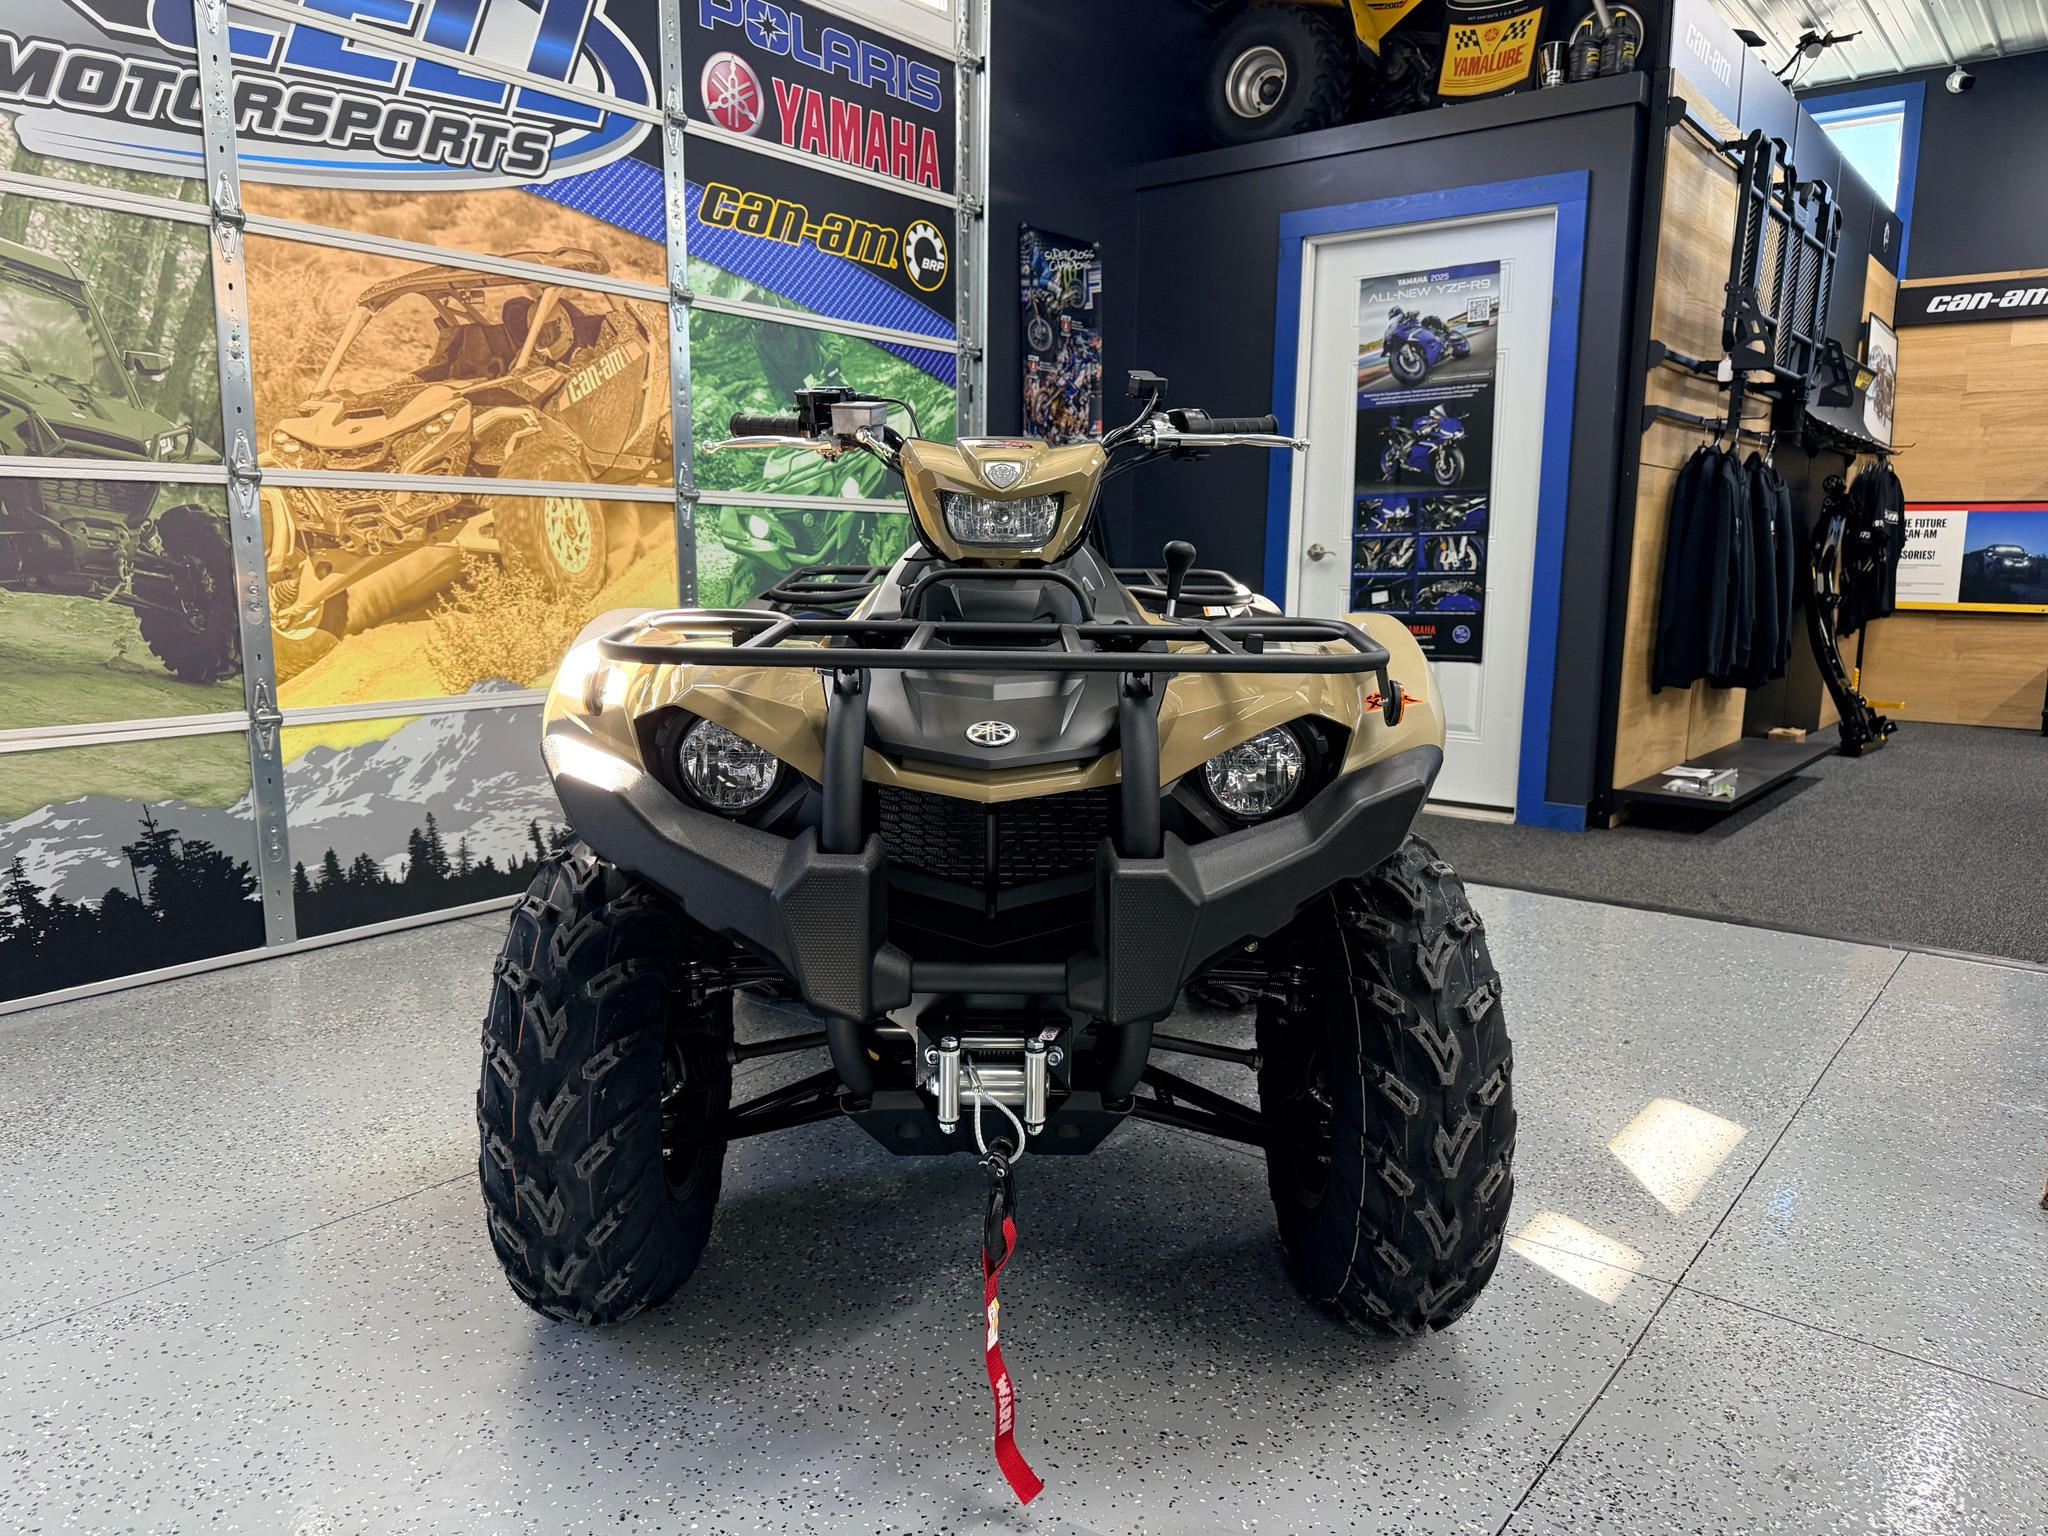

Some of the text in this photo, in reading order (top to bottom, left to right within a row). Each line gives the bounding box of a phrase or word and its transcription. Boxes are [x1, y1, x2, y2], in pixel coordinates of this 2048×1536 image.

[698, 0, 942, 113] POLARIS
[1453, 45, 1526, 77] YAMALUBE
[771, 76, 941, 191] YAMAHA
[920, 257, 945, 273] BRP
[1368, 278, 1491, 304] ALL-NEW YZF-R9
[1397, 273, 1450, 287] YAMAHA 2025
[1925, 287, 2048, 314] can-am
[568, 348, 626, 403] can-am
[1915, 518, 1948, 528] FUTURE
[1405, 625, 1437, 635] AMAHA
[995, 1372, 1013, 1436] WARN
